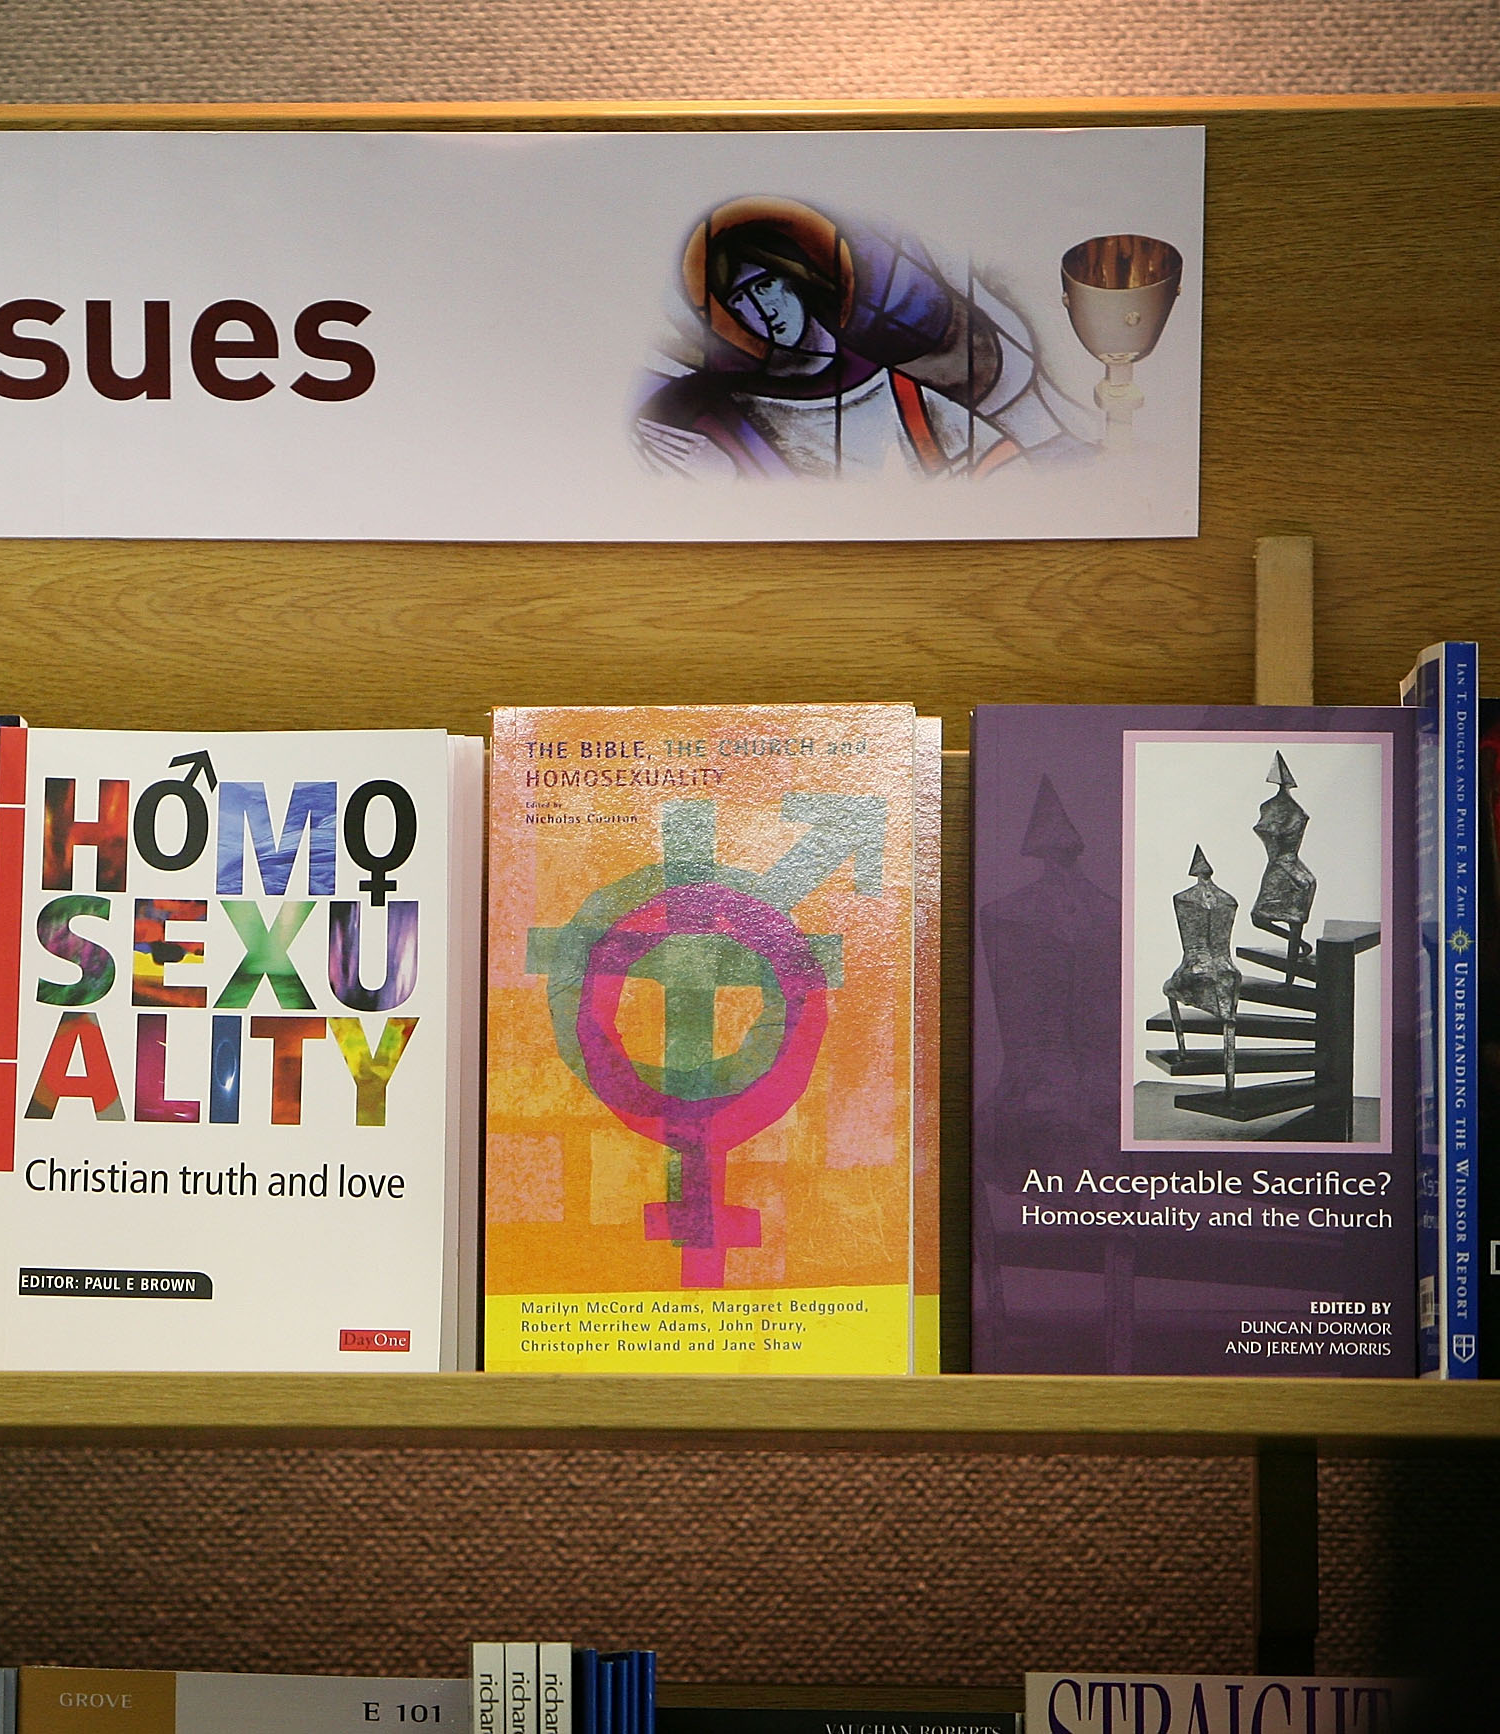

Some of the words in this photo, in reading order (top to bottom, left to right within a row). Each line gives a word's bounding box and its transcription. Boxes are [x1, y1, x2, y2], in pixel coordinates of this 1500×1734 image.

[1456, 663, 1467, 685] IAN
[526, 741, 567, 758] THE
[581, 741, 652, 760] BIBLE,
[665, 739, 707, 757] THE
[718, 738, 814, 756] CHURCH
[827, 738, 867, 755] and
[1456, 711, 1467, 770] DOUGLAS
[526, 768, 725, 788] HOMOSEXUALITY
[1456, 776, 1465, 802] AND
[41, 752, 417, 905] HOMO
[526, 813, 581, 824] Nicholas
[1456, 808, 1467, 838] PAUL
[1456, 885, 1467, 918] ZAHL
[36, 895, 419, 1012] SEXU
[1454, 962, 1468, 1109] UNDERSTANDING
[23, 1011, 420, 1126] ALITY
[1455, 1119, 1467, 1151] THE
[25, 1158, 168, 1194] Christian
[179, 1162, 257, 1196] truth
[268, 1163, 328, 1197] and
[338, 1164, 405, 1198] love
[1022, 1169, 1064, 1193] An
[1075, 1169, 1242, 1200] Acceptable
[1252, 1170, 1391, 1197] Sacrifice?
[1455, 1159, 1469, 1242] WINDSOR
[1022, 1206, 1200, 1231] Homosexuality
[1208, 1207, 1252, 1227] and
[1262, 1208, 1300, 1227] the
[1308, 1208, 1392, 1228] Church
[21, 1274, 79, 1290] EDITOR:
[84, 1276, 120, 1291] PAUL
[127, 1277, 134, 1291] E
[140, 1277, 196, 1293] BROWN
[1456, 1252, 1470, 1319] REPORT
[521, 1301, 579, 1316] Marilyn
[587, 1301, 644, 1313] McCord
[652, 1301, 704, 1315] Adams,
[713, 1301, 782, 1316] Margaret
[790, 1300, 868, 1315] Bedggood,
[1311, 1301, 1365, 1314] EDITED
[1371, 1302, 1392, 1315] BY
[521, 1320, 571, 1332] Robert
[580, 1320, 650, 1332] Merrihew
[658, 1320, 711, 1333] Adams,
[719, 1320, 753, 1332] John
[762, 1319, 806, 1333] Drury,
[1241, 1321, 1312, 1335] DUNCAN
[1318, 1322, 1392, 1335] DORMOR
[521, 1339, 610, 1354] Christopher
[618, 1339, 680, 1351] Rowland
[689, 1339, 715, 1351] and
[722, 1339, 756, 1351] Jane
[764, 1338, 802, 1351] Shaw
[1225, 1341, 1261, 1354] AND
[1267, 1342, 1324, 1357] JEREMY
[1329, 1342, 1391, 1355] MORRIS
[59, 1691, 133, 1709] GROVE
[363, 1701, 381, 1722] E
[397, 1702, 443, 1723] 101
[511, 1671, 531, 1734] richar
